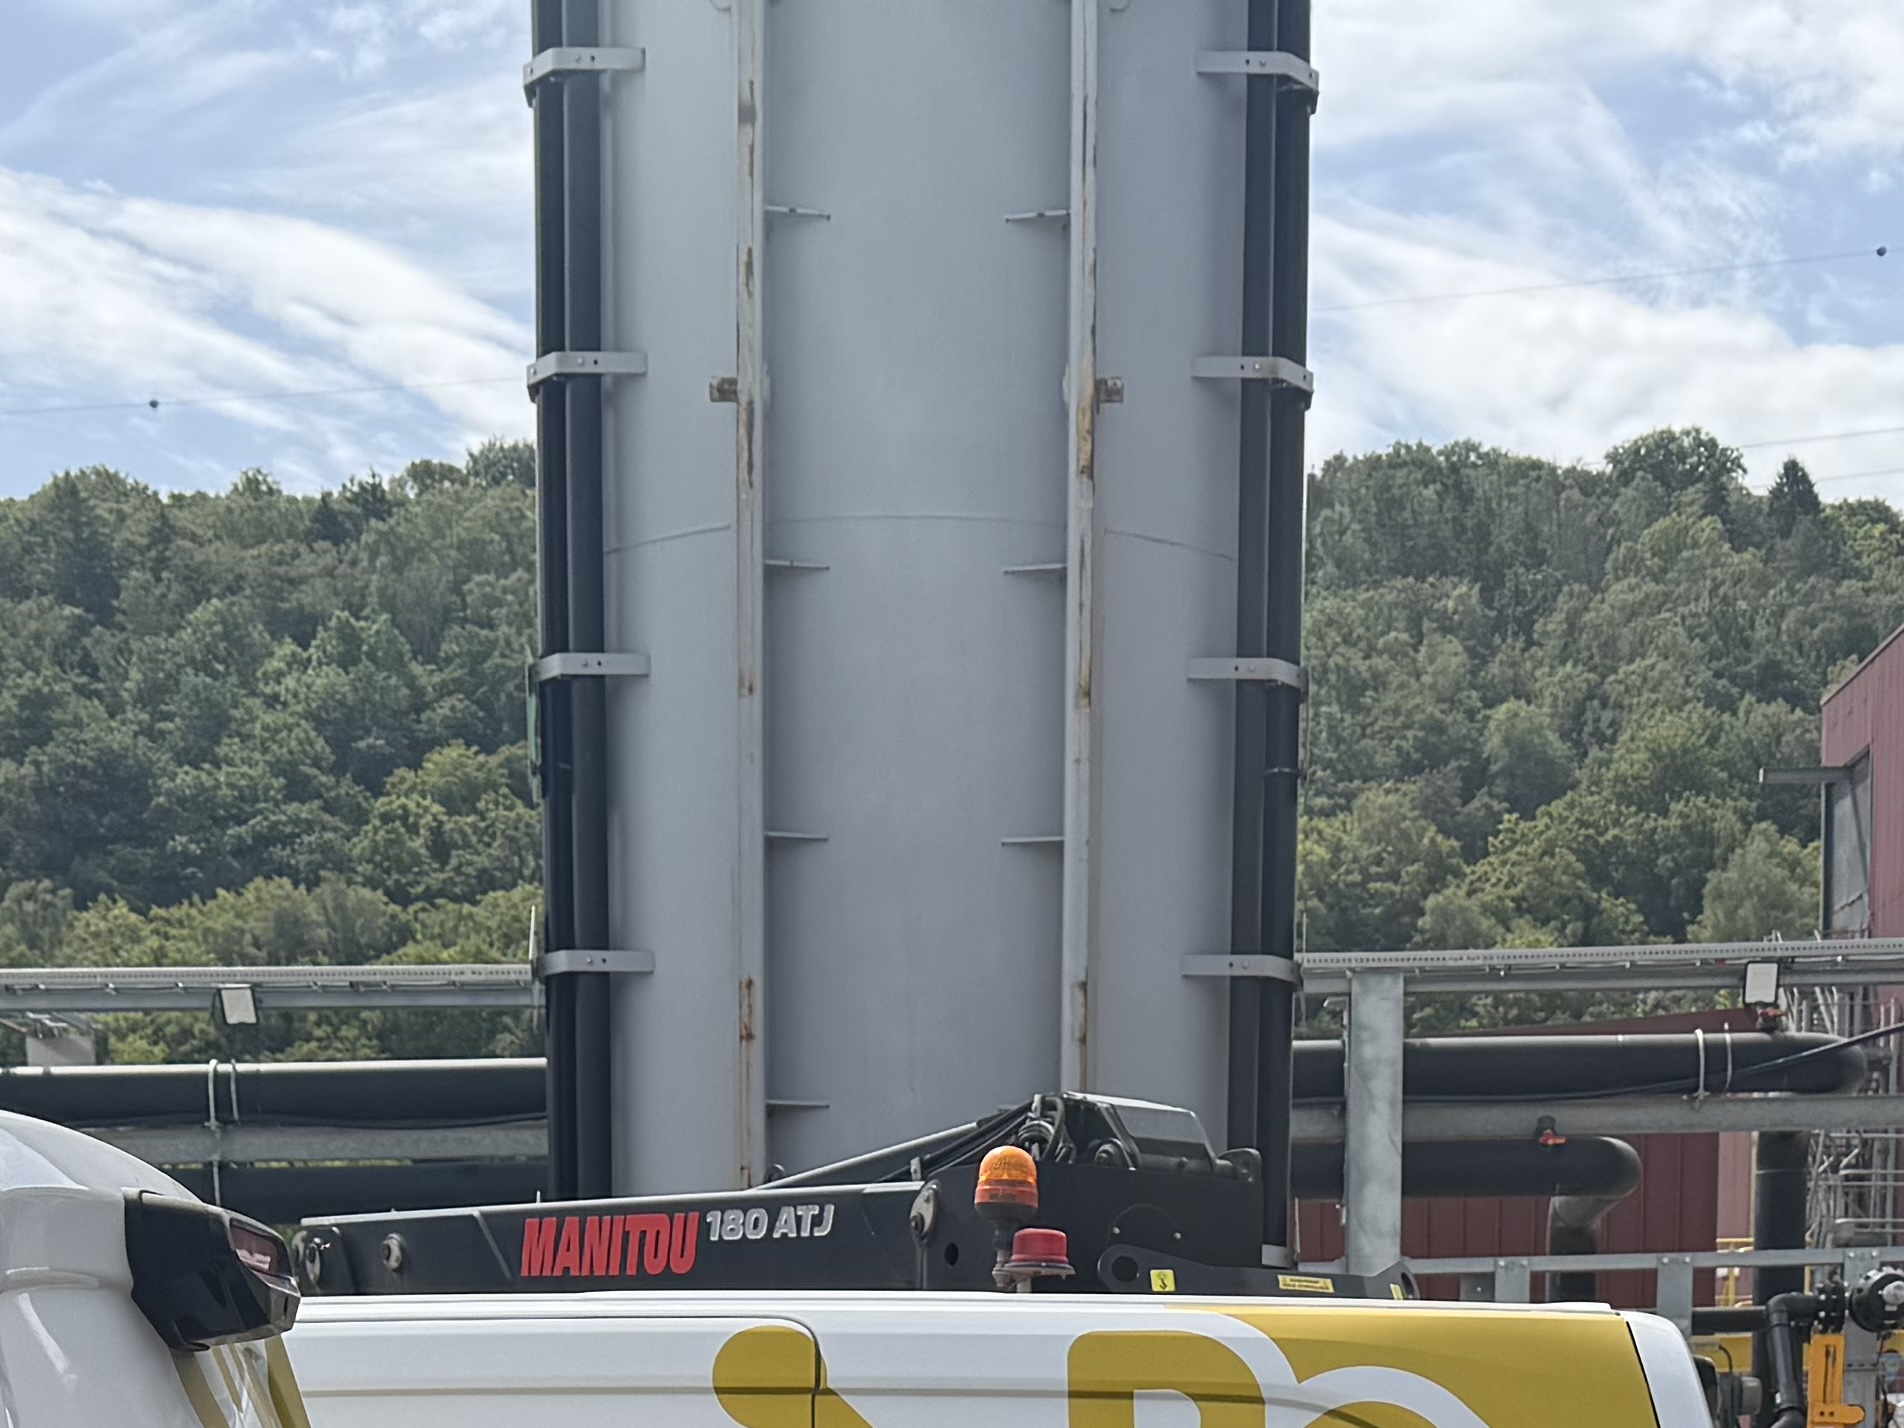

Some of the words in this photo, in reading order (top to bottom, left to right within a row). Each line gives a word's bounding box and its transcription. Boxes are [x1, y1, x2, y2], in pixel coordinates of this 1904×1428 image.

[520, 1211, 699, 1277] MANITOU
[706, 1207, 767, 1241] 180
[772, 1204, 835, 1237] ATJ
